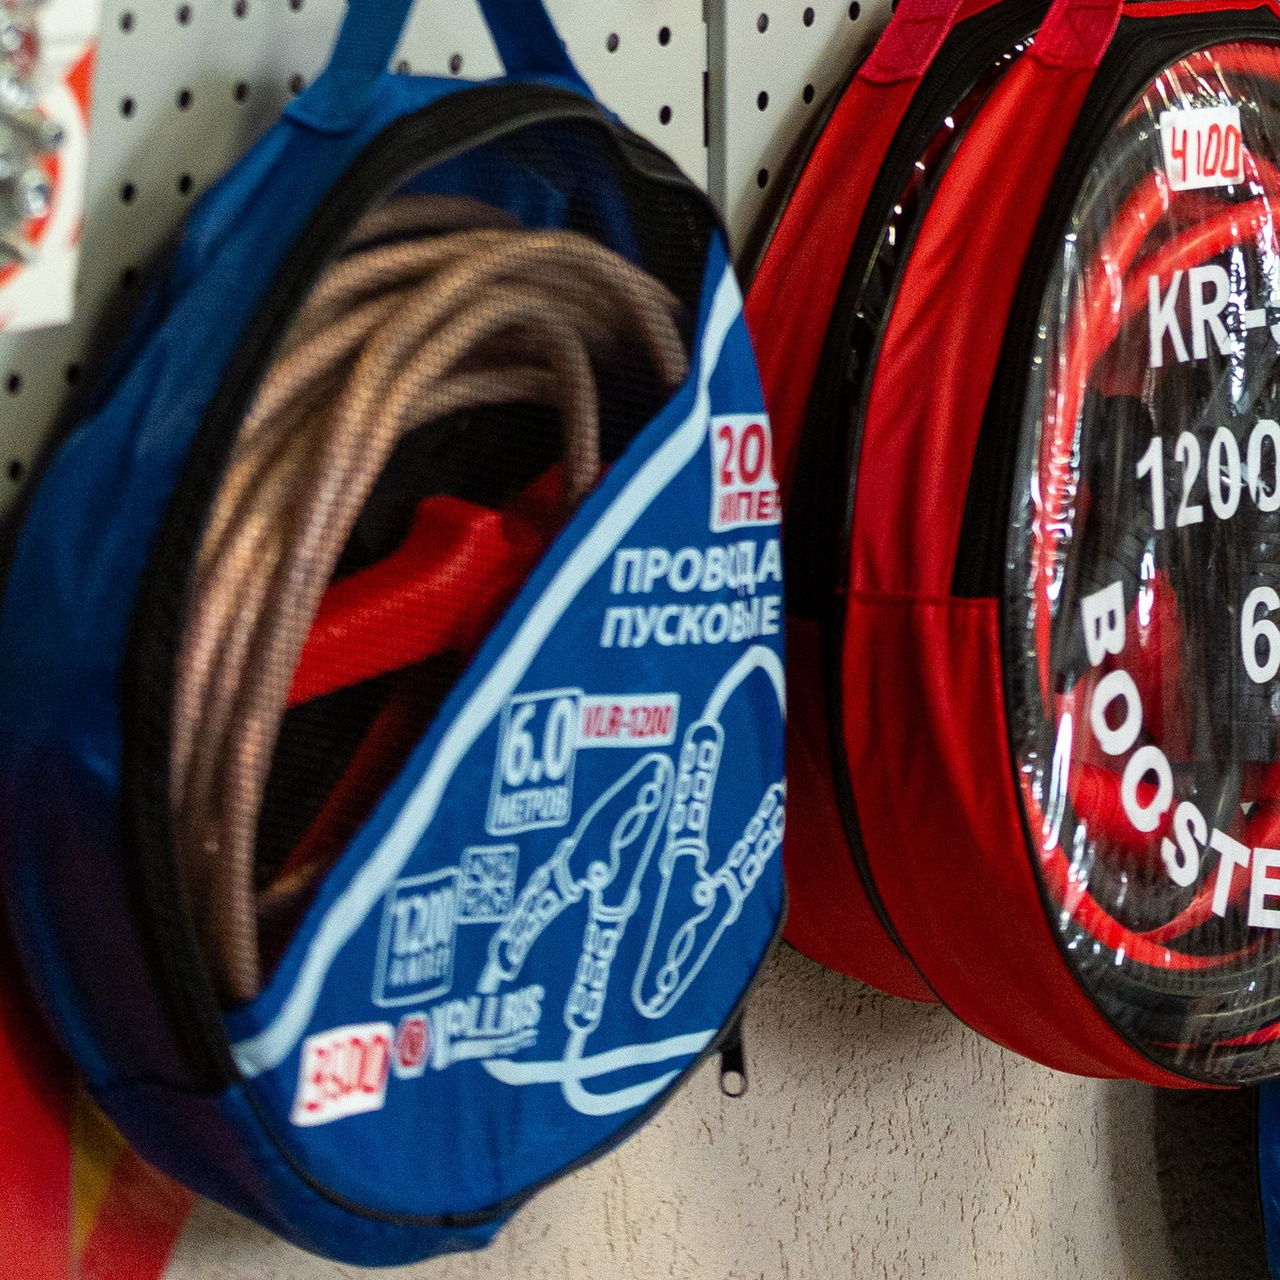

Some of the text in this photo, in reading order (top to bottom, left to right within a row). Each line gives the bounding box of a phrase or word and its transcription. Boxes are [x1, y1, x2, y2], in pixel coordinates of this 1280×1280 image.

[1169, 123, 1243, 177] 4100
[610, 539, 783, 596] ПРОВОДА
[601, 595, 782, 649] ПУСКОВЫЕ
[502, 696, 576, 787] 6.0
